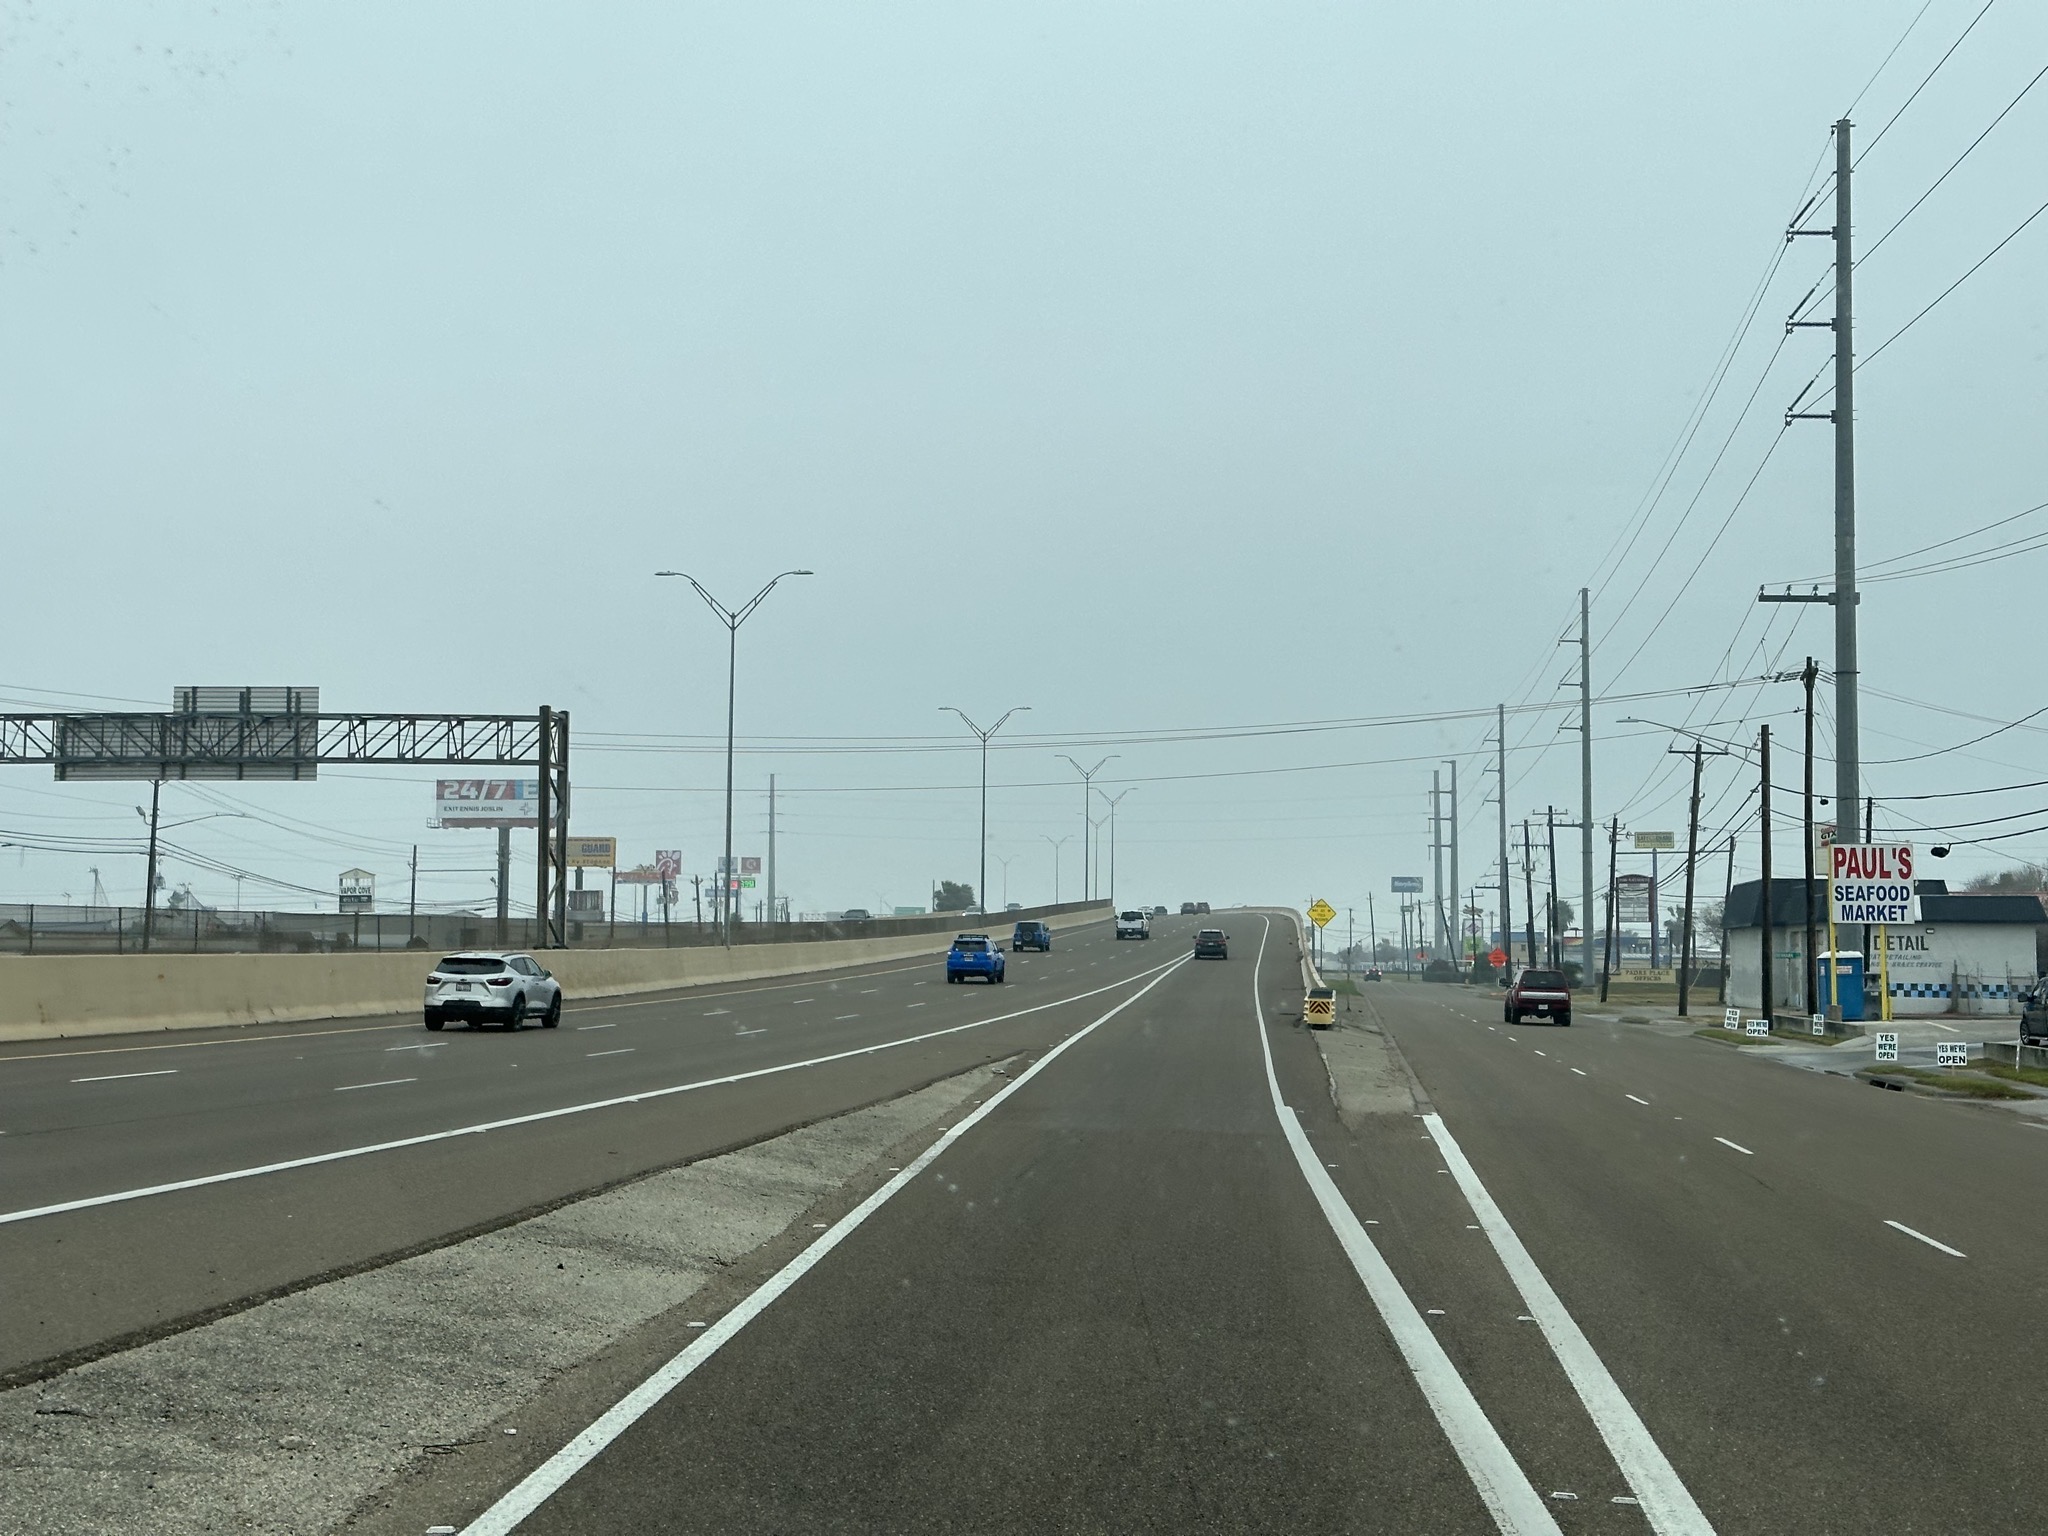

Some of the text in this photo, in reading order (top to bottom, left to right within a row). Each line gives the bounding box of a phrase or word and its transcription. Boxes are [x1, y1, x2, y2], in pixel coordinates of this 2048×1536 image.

[444, 780, 508, 800] 24/7
[1820, 830, 1836, 839] GTX
[1834, 848, 1912, 879] PAUL'S
[1835, 886, 1910, 901] SEAFOOD
[1841, 905, 1907, 921] MARKET
[1874, 936, 1929, 950] DETAIL
